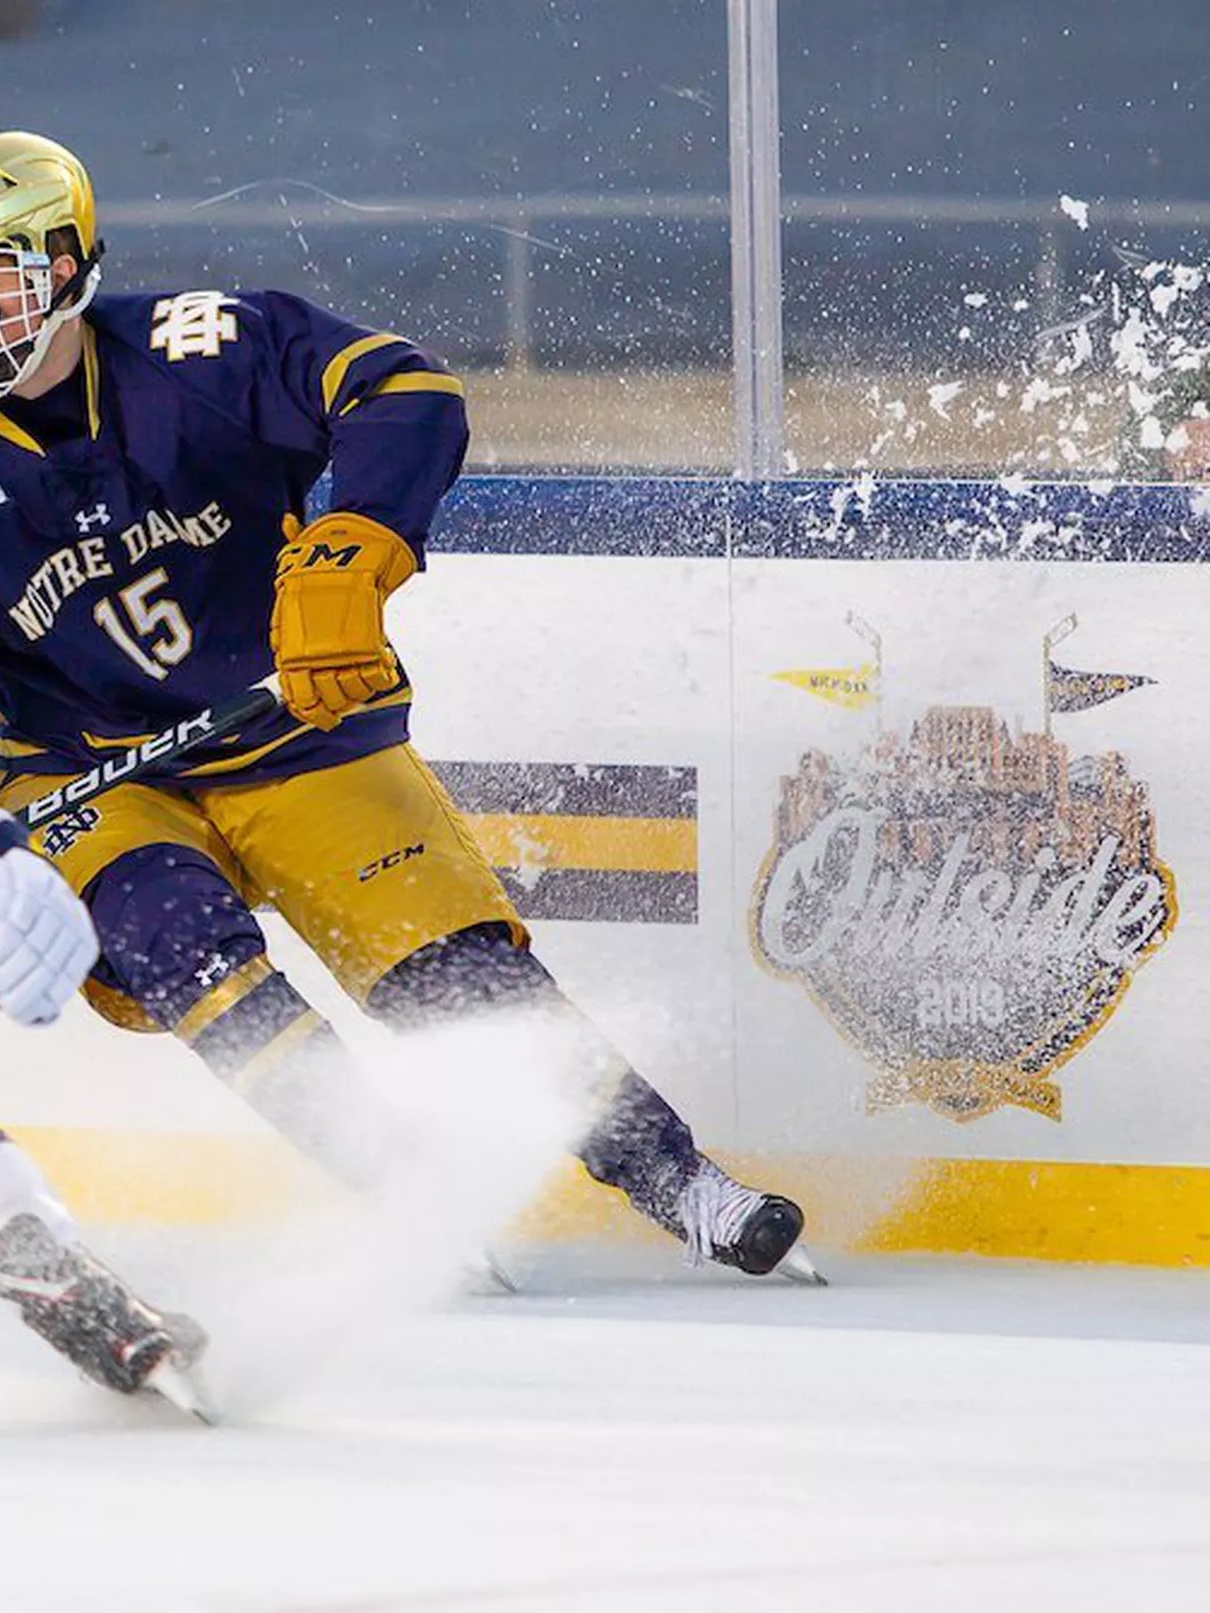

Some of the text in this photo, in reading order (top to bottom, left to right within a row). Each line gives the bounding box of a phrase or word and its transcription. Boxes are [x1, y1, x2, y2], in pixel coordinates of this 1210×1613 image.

[8, 501, 232, 642] NOTRE DAME
[93, 566, 192, 681] 15
[28, 708, 212, 825] BAUER
[359, 843, 425, 883] CCM
[760, 805, 1166, 967] Outside
